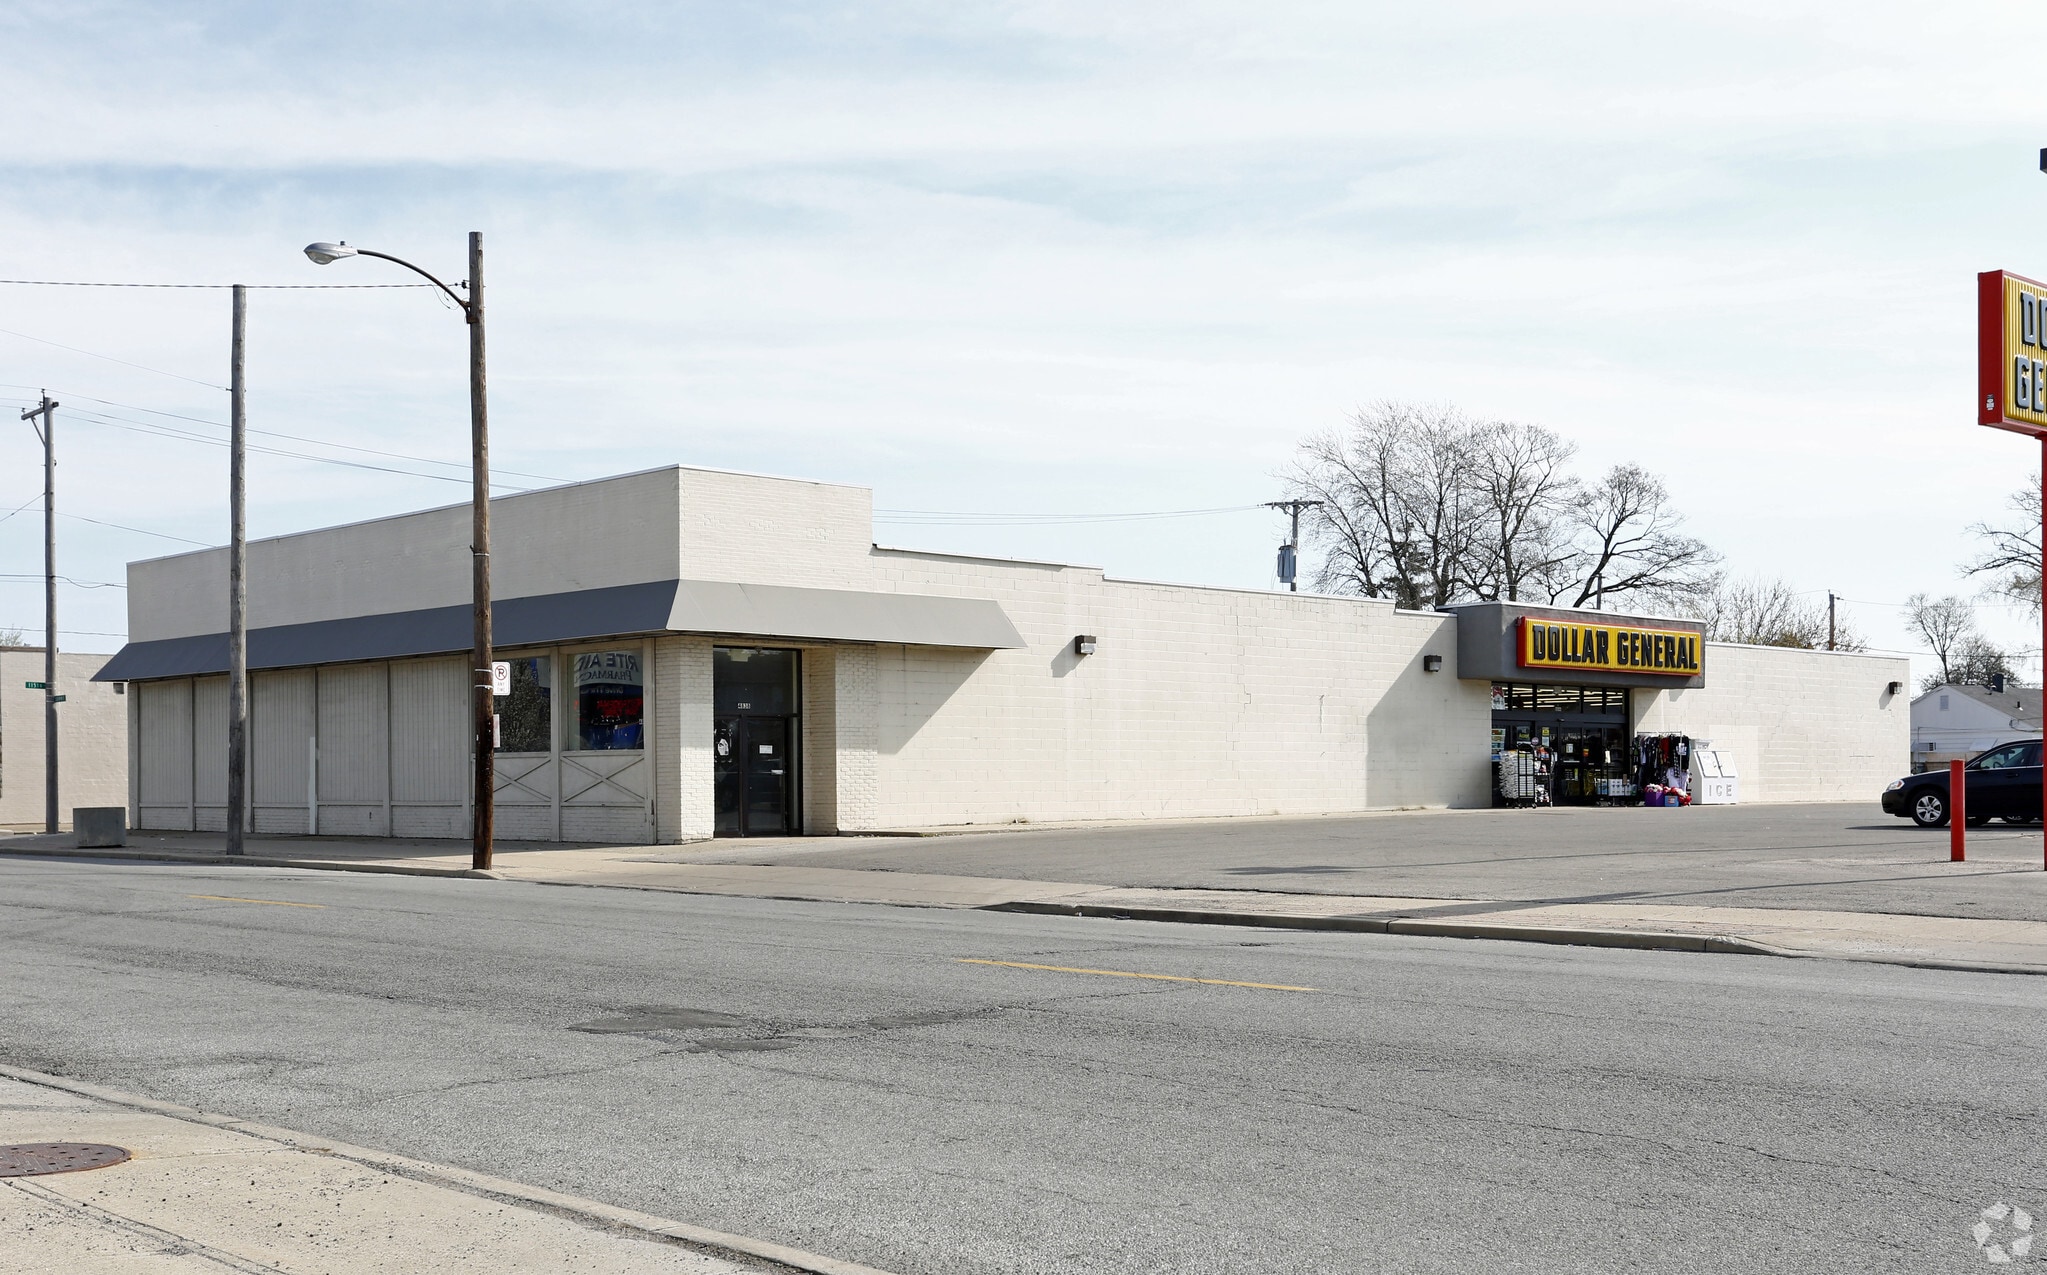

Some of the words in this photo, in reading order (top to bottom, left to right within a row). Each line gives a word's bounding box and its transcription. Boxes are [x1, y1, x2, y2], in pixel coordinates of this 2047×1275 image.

[1533, 624, 1609, 665] DOLLAR
[1617, 630, 1698, 670] GENERAL
[1708, 784, 1733, 797] ICE
